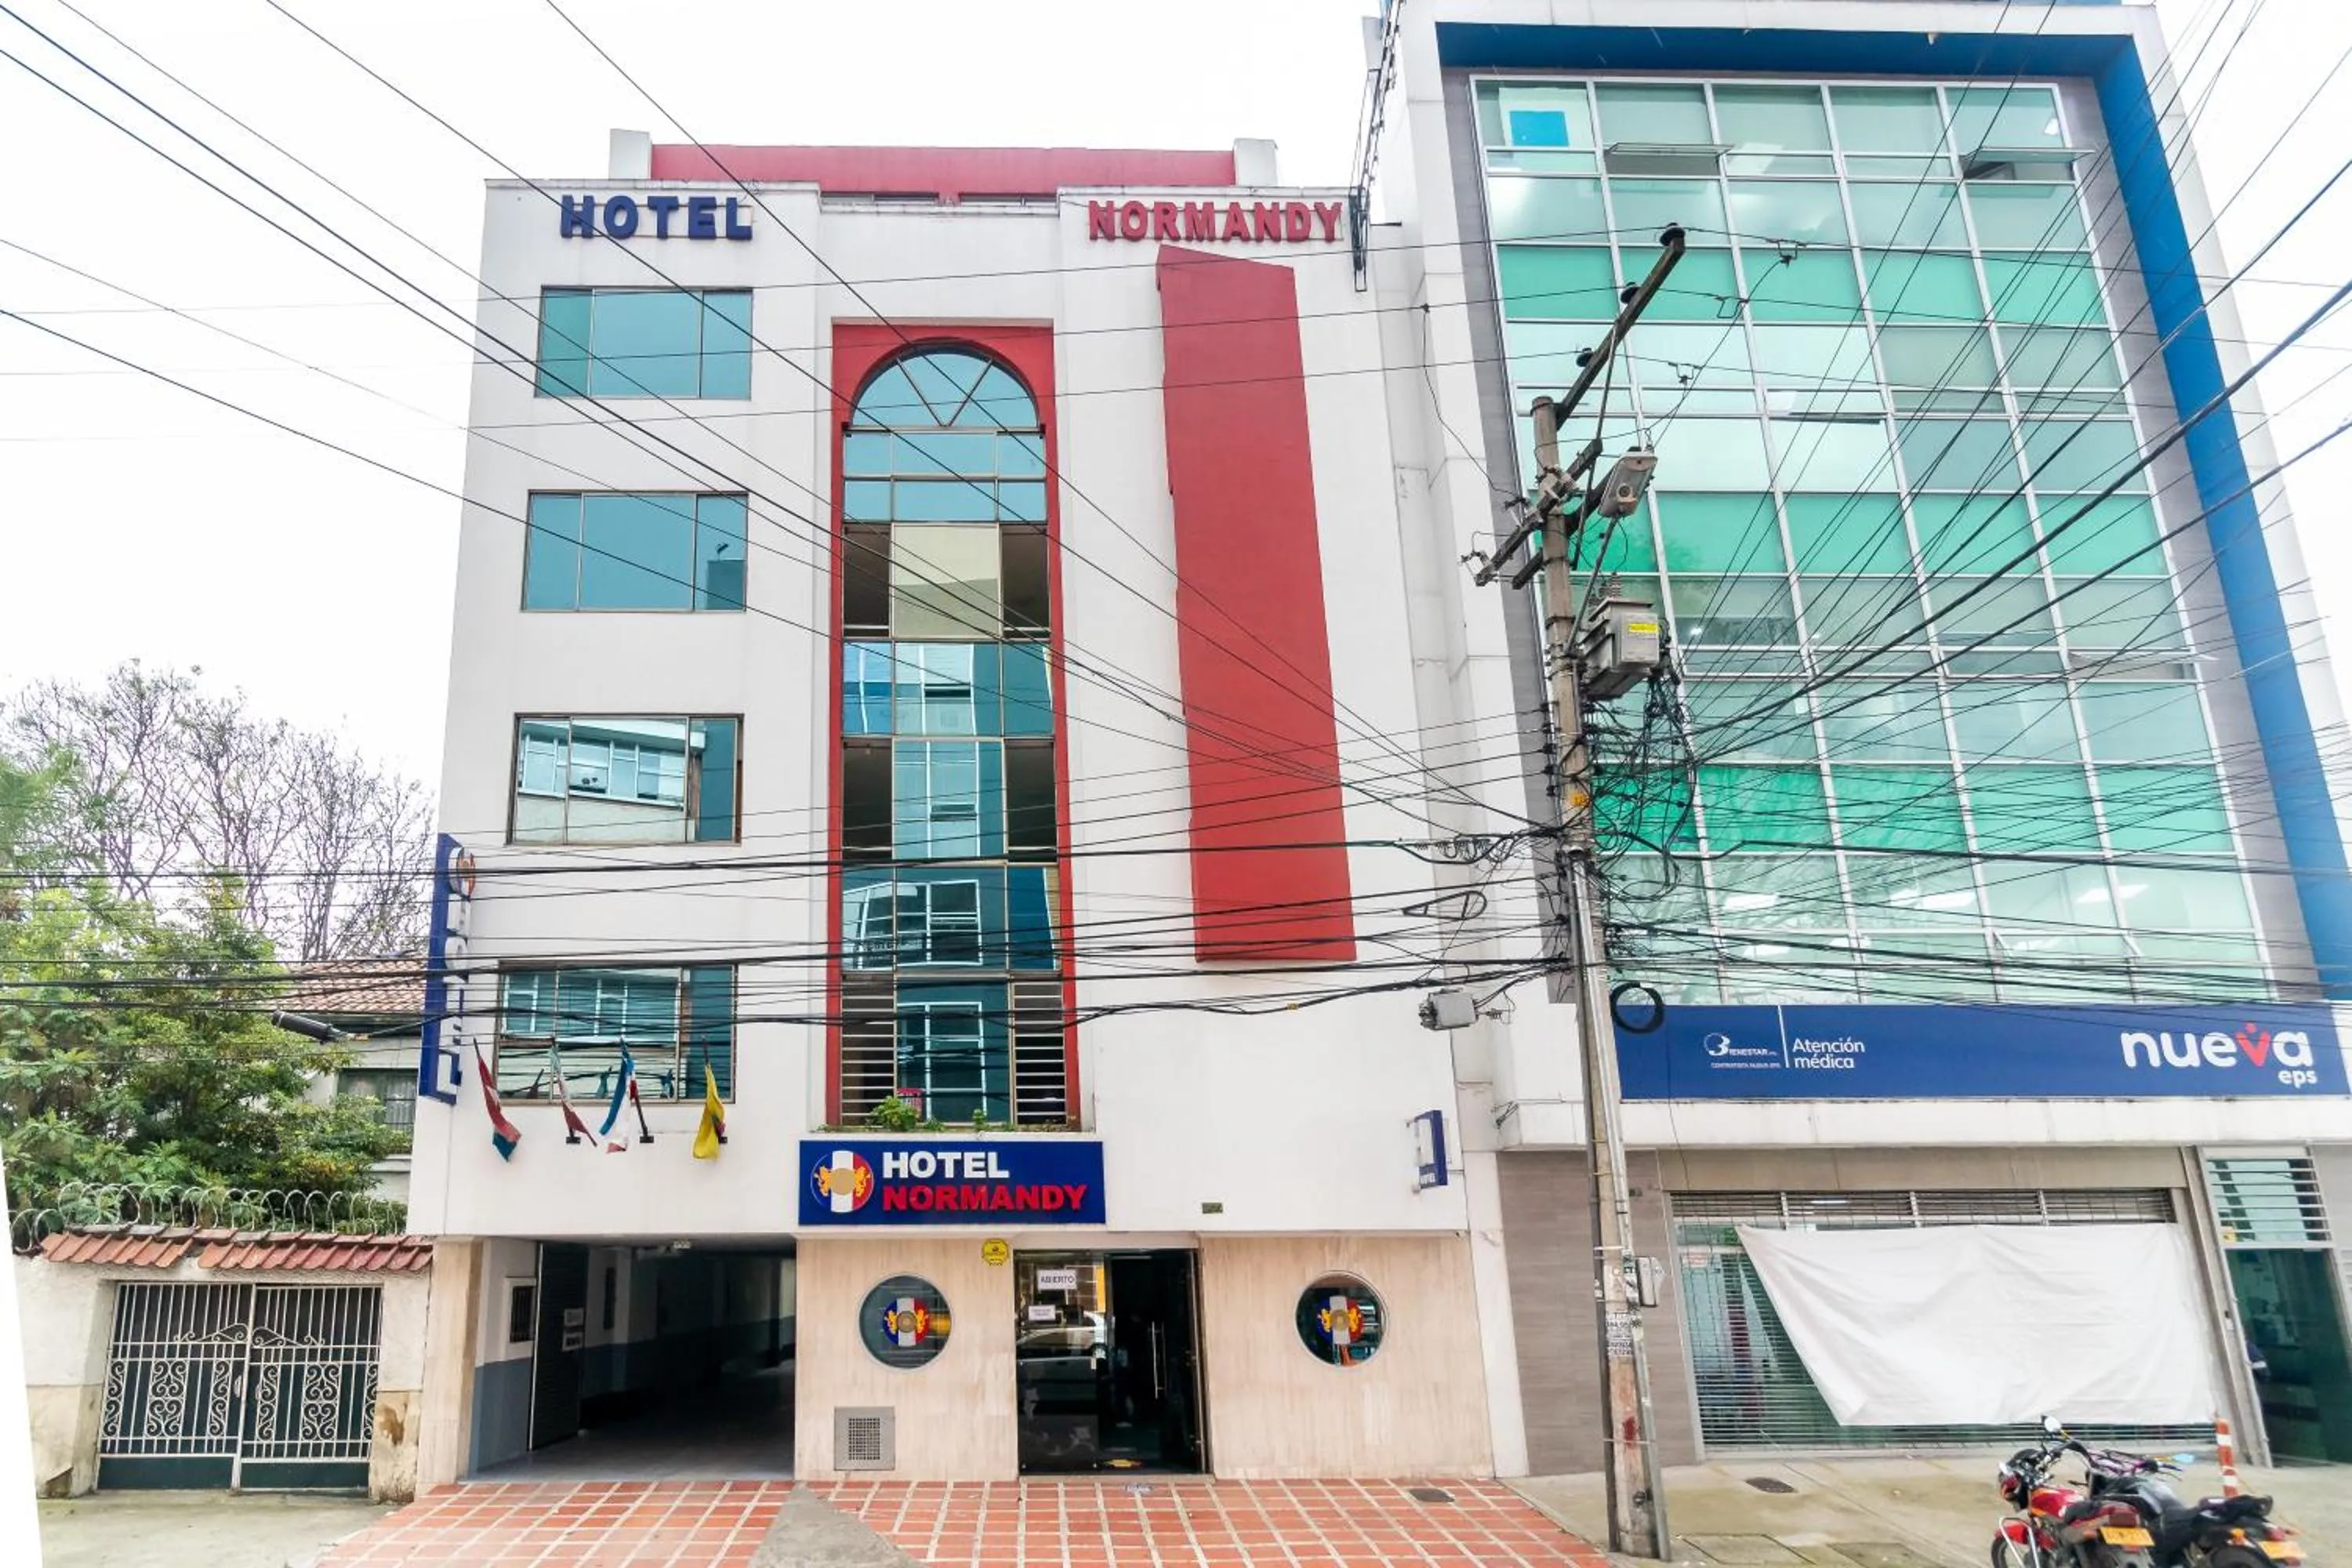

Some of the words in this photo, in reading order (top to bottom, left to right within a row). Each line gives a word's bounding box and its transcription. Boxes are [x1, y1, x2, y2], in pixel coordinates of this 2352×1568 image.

[561, 194, 753, 240] HOTEL
[1088, 200, 1343, 244] NORMANDY
[1792, 1036, 1865, 1053] Atención
[2120, 1023, 2314, 1068] nueva
[1794, 1054, 1855, 1069] médica
[2278, 1069, 2318, 1088] eps
[883, 1152, 1010, 1178] HOTEL
[882, 1185, 1087, 1212] NORMANDY
[1040, 1275, 1075, 1283] ABIERTO
